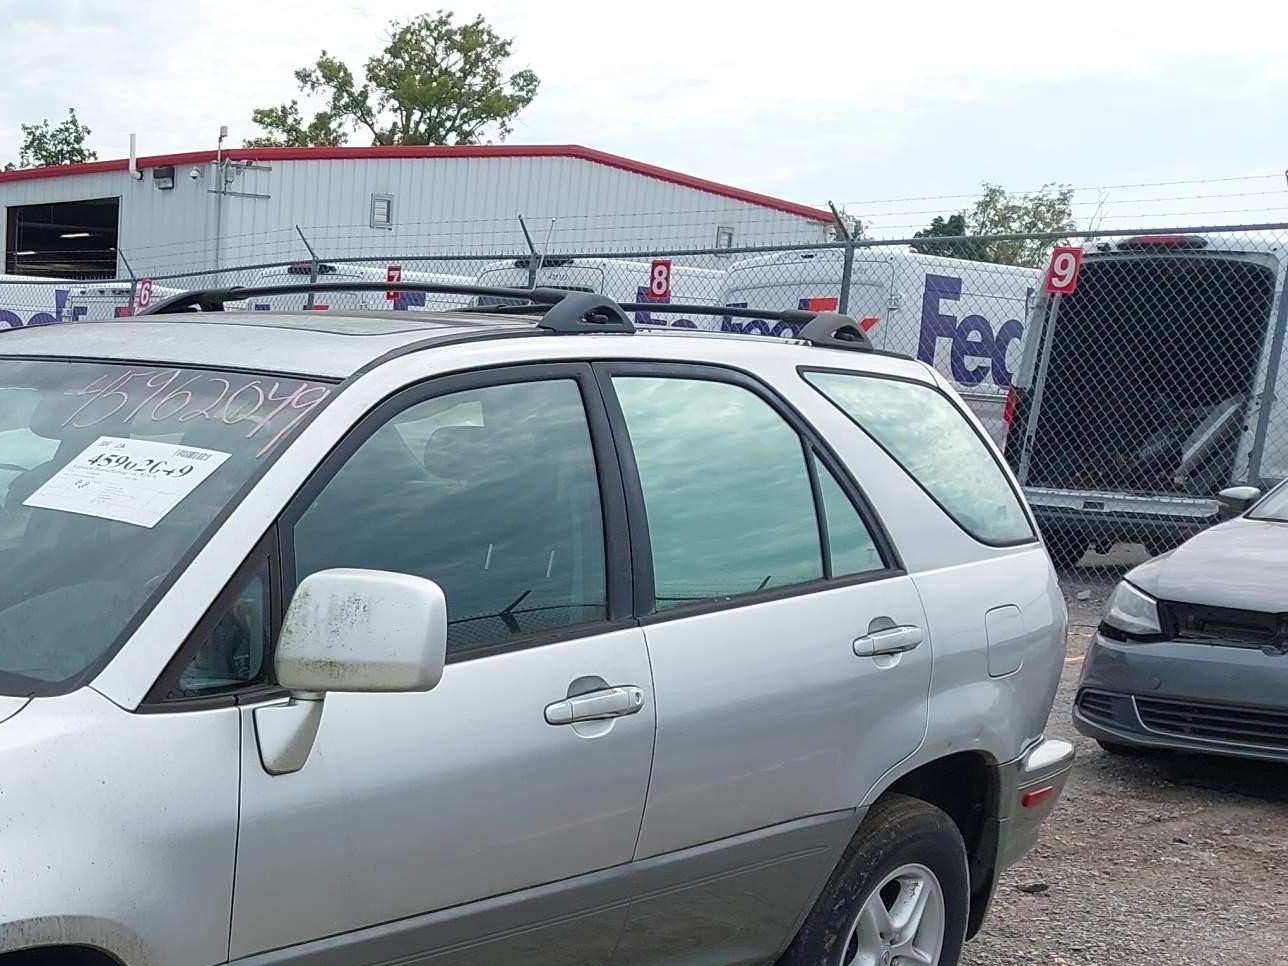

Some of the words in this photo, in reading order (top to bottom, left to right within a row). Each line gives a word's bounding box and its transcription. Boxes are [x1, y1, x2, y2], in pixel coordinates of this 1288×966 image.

[650, 264, 668, 295] 8
[1051, 252, 1077, 288] 9
[140, 282, 150, 305] 6
[62, 369, 331, 459] 45962049
